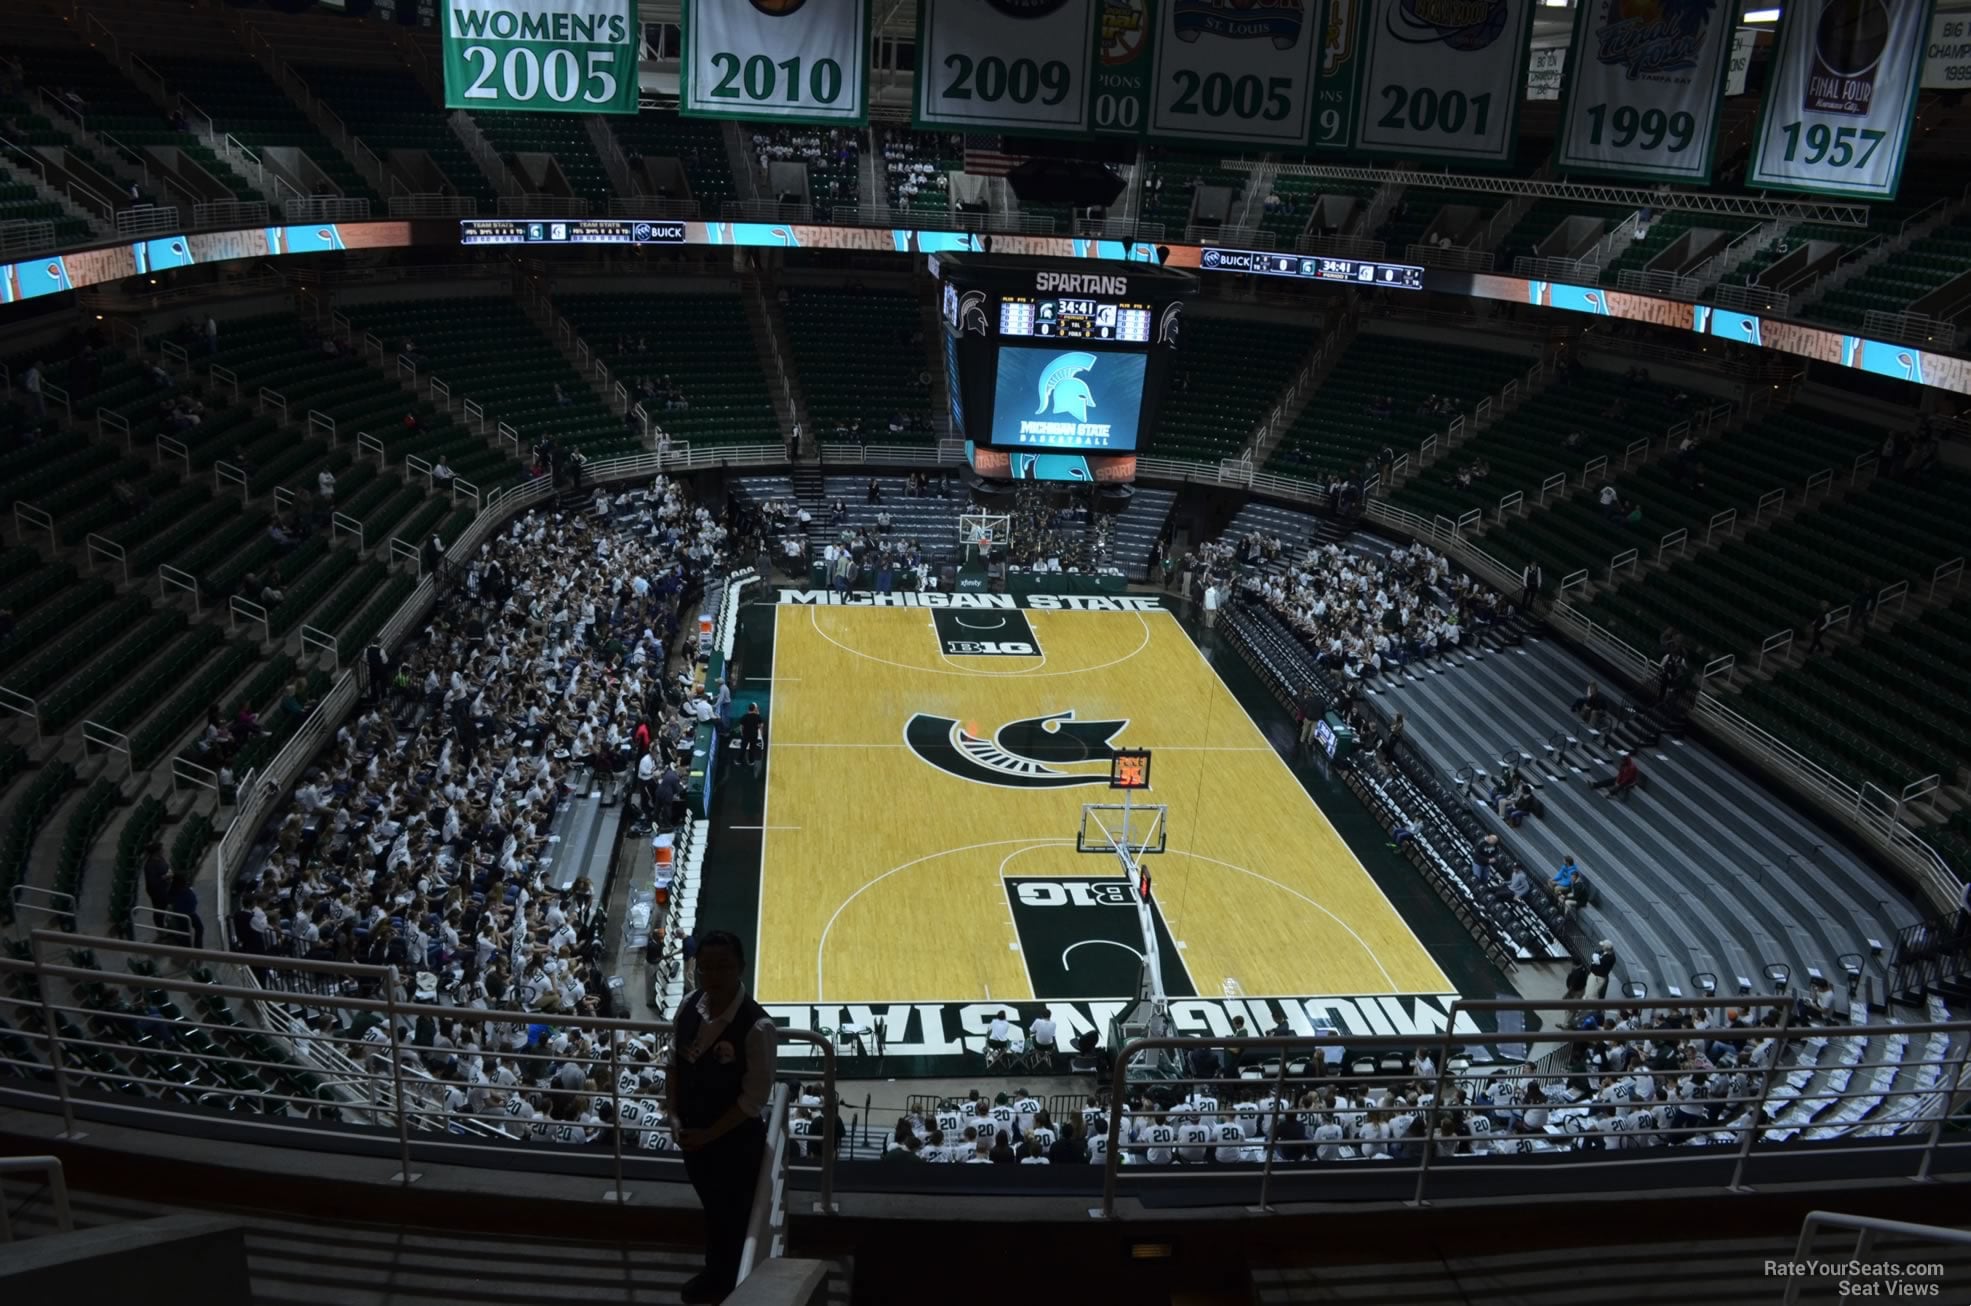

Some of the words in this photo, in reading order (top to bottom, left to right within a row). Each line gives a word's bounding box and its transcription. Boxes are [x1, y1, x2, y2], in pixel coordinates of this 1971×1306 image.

[454, 9, 625, 42] WOMEN'S
[1943, 22, 1963, 37] BIG
[463, 46, 616, 103] 2005
[710, 52, 842, 104] 2010
[942, 54, 1070, 105] 2009
[1170, 70, 1292, 120] 2005
[1809, 76, 1839, 99] FINAL
[1842, 80, 1872, 102] FOUR
[1378, 84, 1491, 135] 2001
[1587, 104, 1695, 153] 1999
[1782, 121, 1886, 168] 1957
[651, 227, 682, 238] BUICK
[795, 227, 893, 251] SPARTANS
[1220, 255, 1250, 266] BUICK
[1279, 259, 1287, 271] 0
[1323, 261, 1351, 273] 34:41
[1385, 269, 1393, 281] 0
[1036, 272, 1127, 296] SPARTANS
[1058, 301, 1093, 315] 34:41
[1606, 293, 1694, 329] SPARTANS
[1041, 323, 1049, 334] 0
[1101, 326, 1109, 337] 0
[1761, 319, 1842, 364] SPARTANS
[1020, 420, 1076, 435] MICHIGAN
[1077, 423, 1111, 437] STATE
[1020, 434, 1109, 446] BASKETBALL
[961, 579, 982, 587] xfinity
[777, 589, 1016, 609] MICHIGAN
[1027, 595, 1169, 611] STATE
[1498, 1084, 1513, 1096] 20
[1614, 1085, 1629, 1099] 20
[1692, 1087, 1708, 1099] 20
[506, 1102, 522, 1116] 20
[621, 1104, 638, 1120] 20
[1020, 1101, 1038, 1114] 20
[1200, 1102, 1215, 1112] 20
[994, 1109, 1010, 1121] 20
[1301, 1114, 1315, 1126] 20
[1639, 1115, 1652, 1128] 20
[531, 1122, 547, 1135] 20
[940, 1118, 956, 1130] 20
[978, 1124, 994, 1137] 20
[1474, 1119, 1489, 1132] 20
[1612, 1119, 1626, 1131] 20
[557, 1125, 572, 1140] 20
[1153, 1129, 1170, 1142] 20
[1189, 1131, 1205, 1142] 20
[1222, 1127, 1239, 1140] 20
[649, 1133, 667, 1150] 20
[1516, 1140, 1532, 1153] 20
